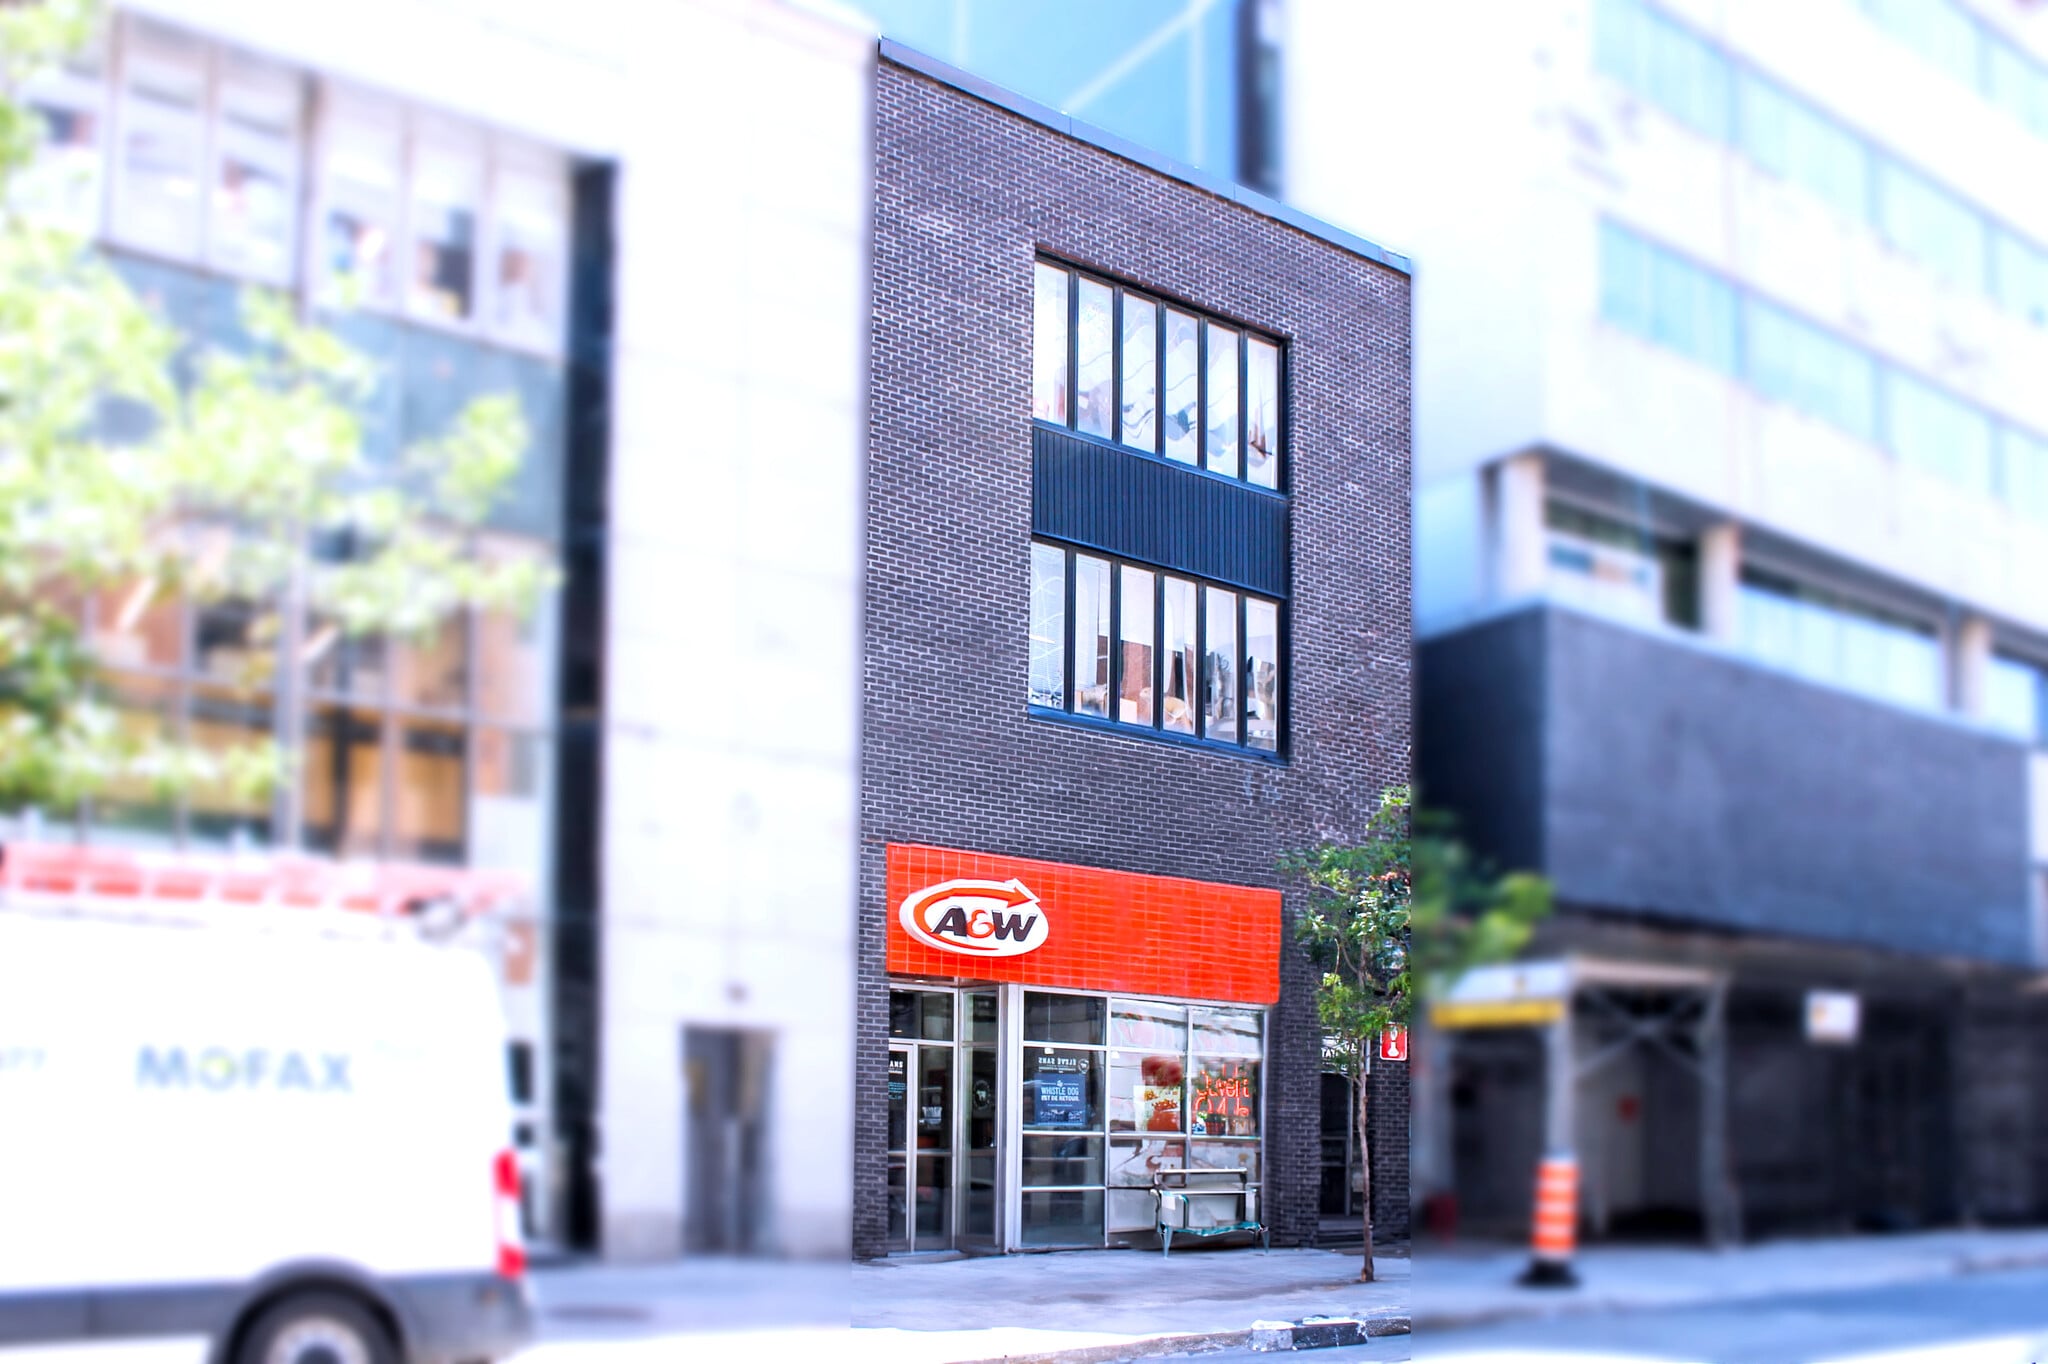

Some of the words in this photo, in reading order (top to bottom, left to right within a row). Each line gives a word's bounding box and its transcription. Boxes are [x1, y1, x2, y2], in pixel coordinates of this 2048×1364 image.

[931, 905, 1038, 943] A&W
[137, 1042, 354, 1095] MOFAX
[1041, 1087, 1066, 1096] WHISTLE
[1067, 1087, 1079, 1096] DOG
